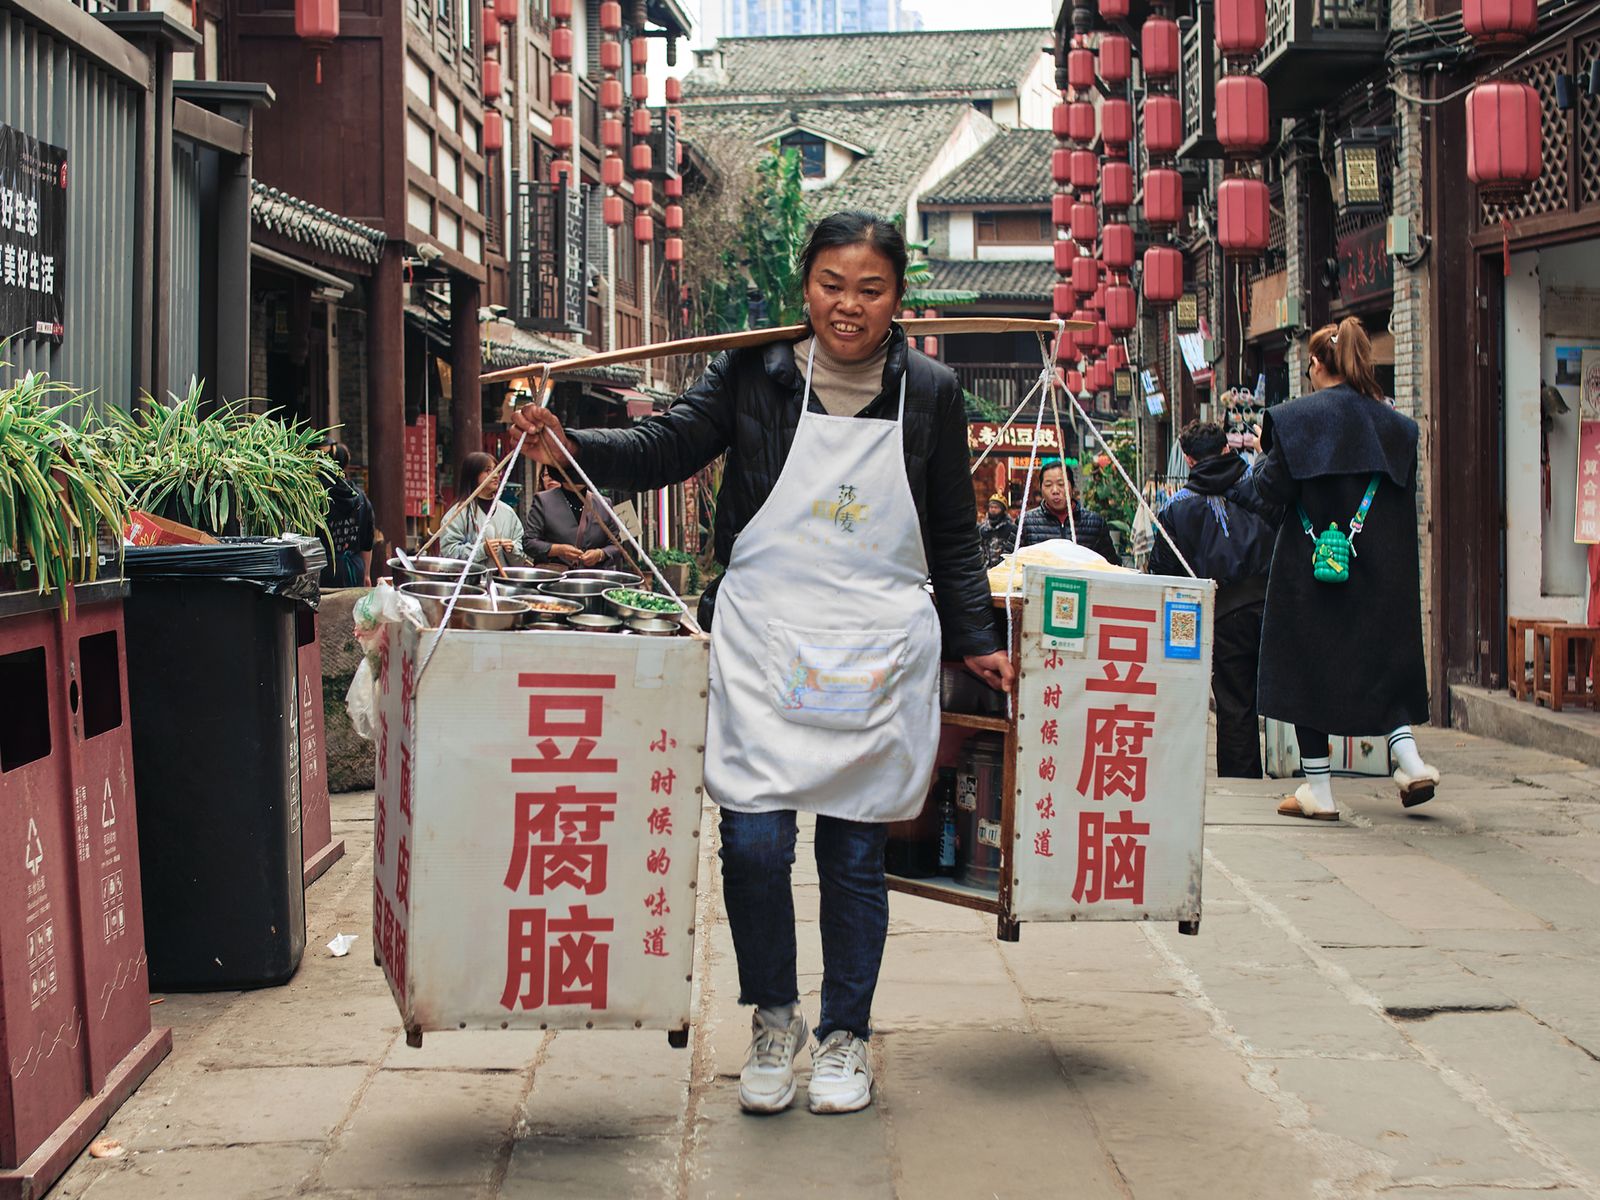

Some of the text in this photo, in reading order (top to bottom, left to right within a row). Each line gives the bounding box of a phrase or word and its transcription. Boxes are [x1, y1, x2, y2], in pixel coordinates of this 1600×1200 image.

[0, 243, 54, 295] 美好生活
[1, 186, 38, 237] 好生态
[500, 672, 618, 1012] 豆腐脑
[643, 729, 677, 958] 小时候的味道
[1033, 649, 1063, 857] 小时候的味道
[1072, 604, 1157, 905] 豆腐脑
[375, 876, 406, 1005] 豆腐脑
